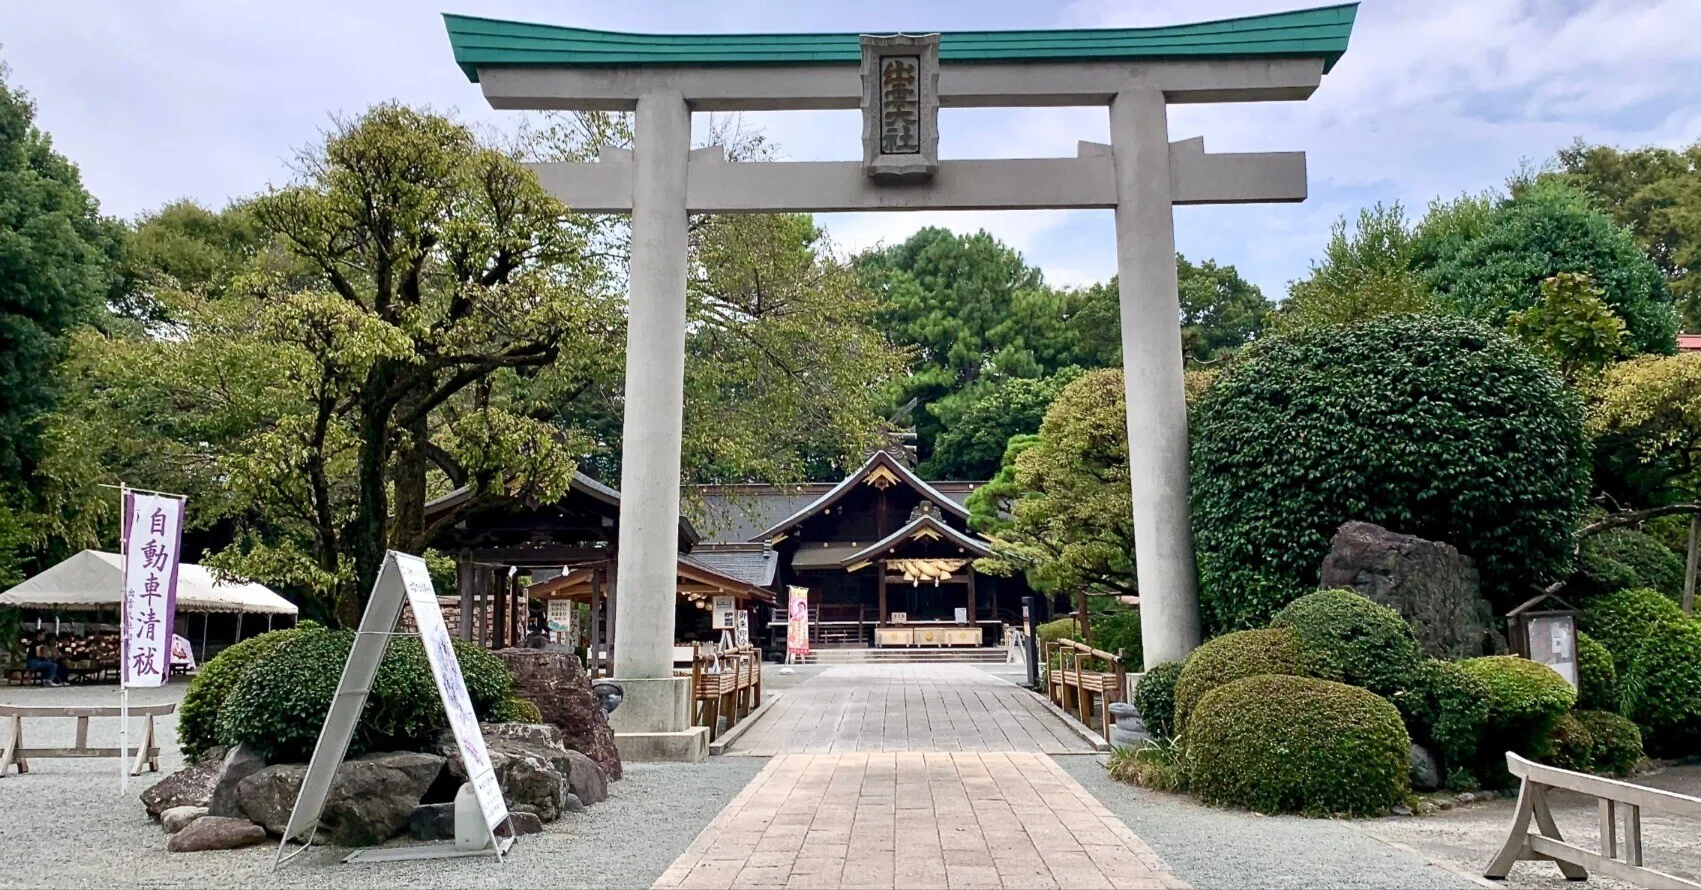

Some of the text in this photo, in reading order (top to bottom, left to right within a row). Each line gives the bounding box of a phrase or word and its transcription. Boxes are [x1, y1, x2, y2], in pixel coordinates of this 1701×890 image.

[883, 59, 918, 152] 出雲大社
[133, 507, 168, 676] 自動車清祓
